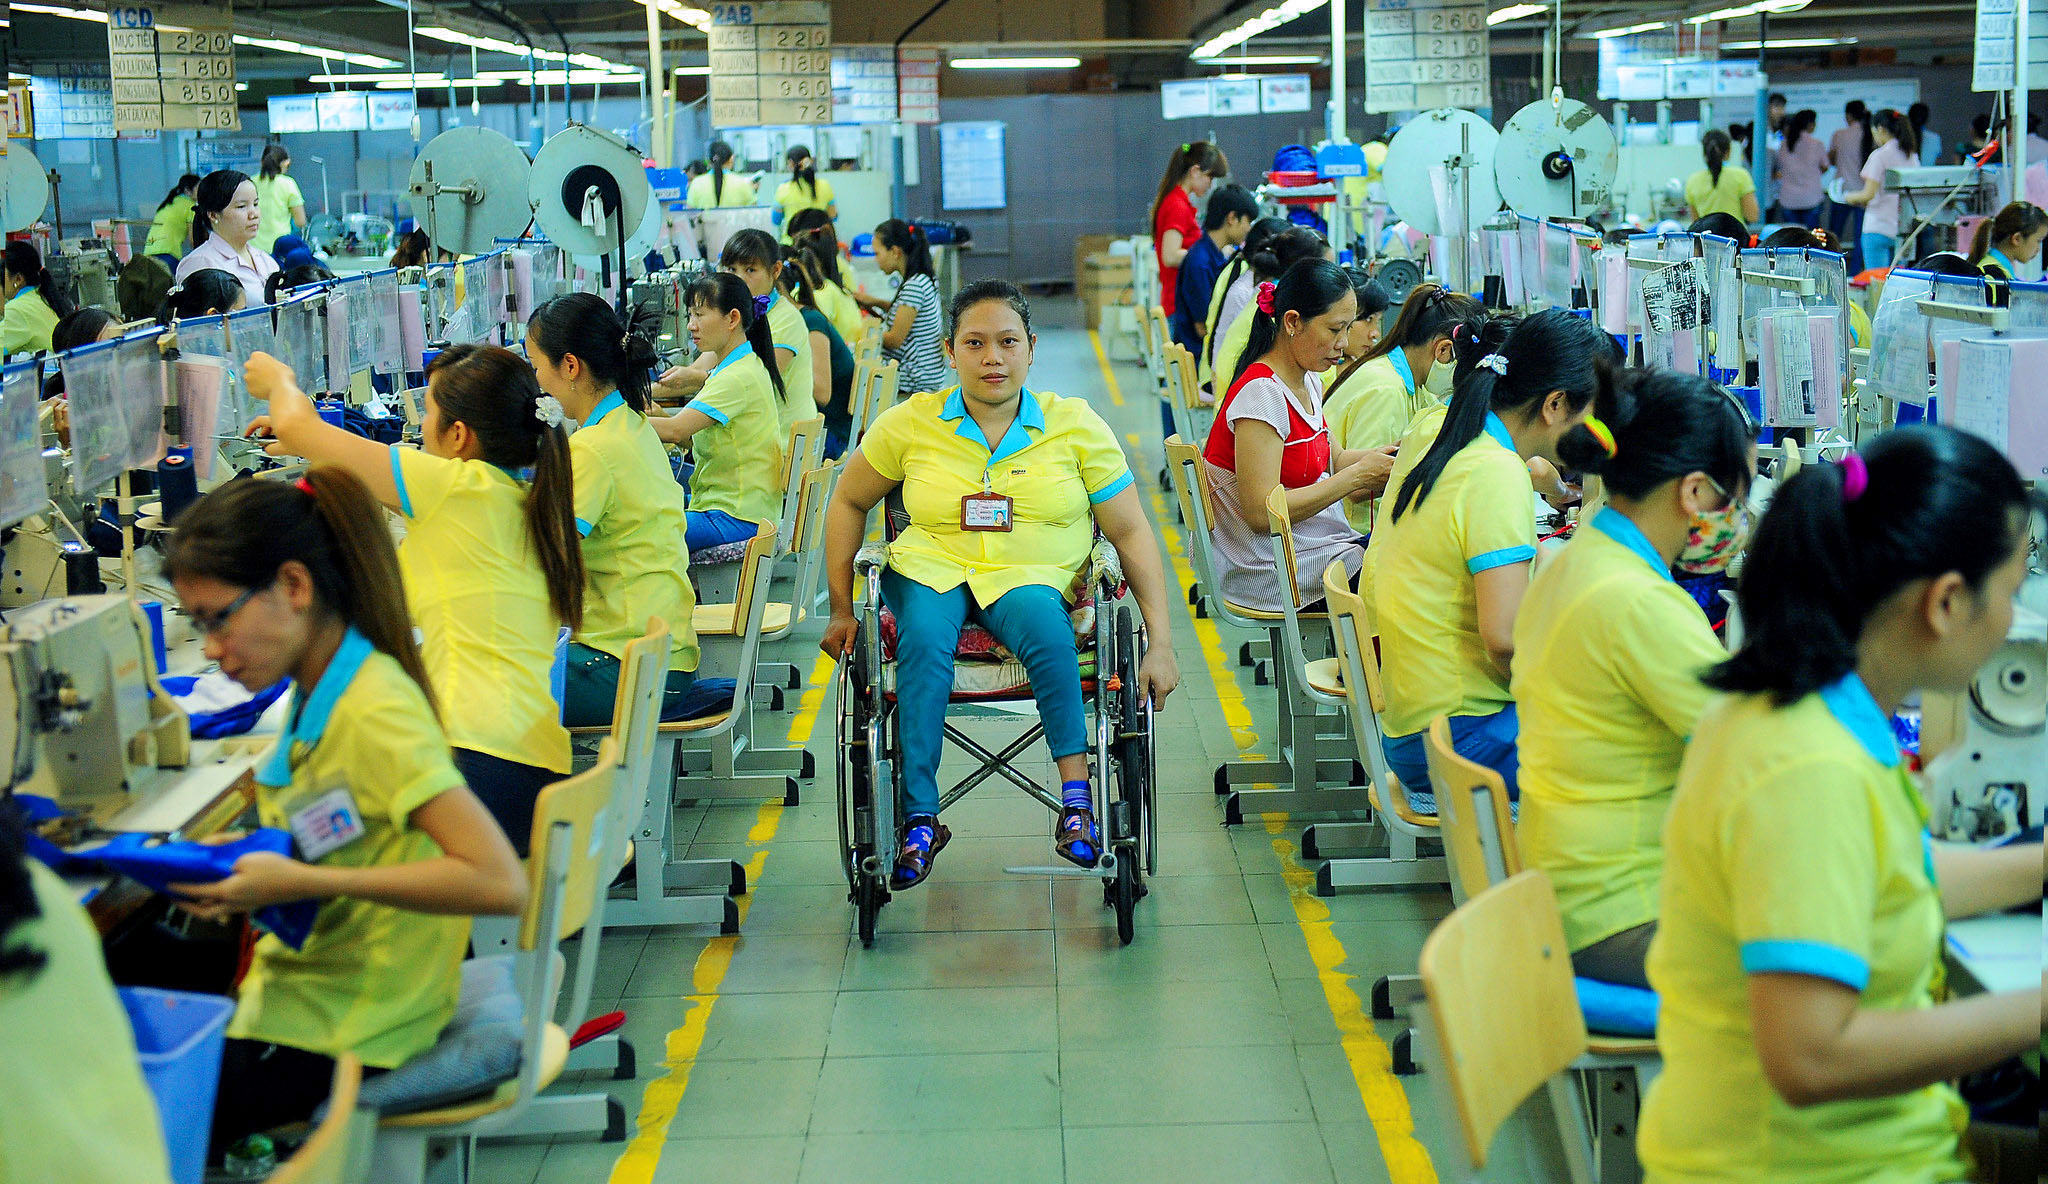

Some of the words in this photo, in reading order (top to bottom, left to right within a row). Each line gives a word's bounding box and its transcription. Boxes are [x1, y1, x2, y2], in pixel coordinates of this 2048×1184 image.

[112, 7, 153, 27] 1CD
[713, 4, 753, 25] 2AB
[1431, 13, 1479, 30] 260
[176, 33, 226, 52] 220
[777, 31, 825, 47] 220
[1431, 38, 1479, 55] 210
[181, 61, 228, 77] 180
[781, 56, 826, 72] 180
[1417, 63, 1479, 80] 1220
[182, 85, 230, 101] 850
[780, 80, 826, 96] 960
[201, 110, 231, 127] 73
[799, 104, 826, 120] 72
